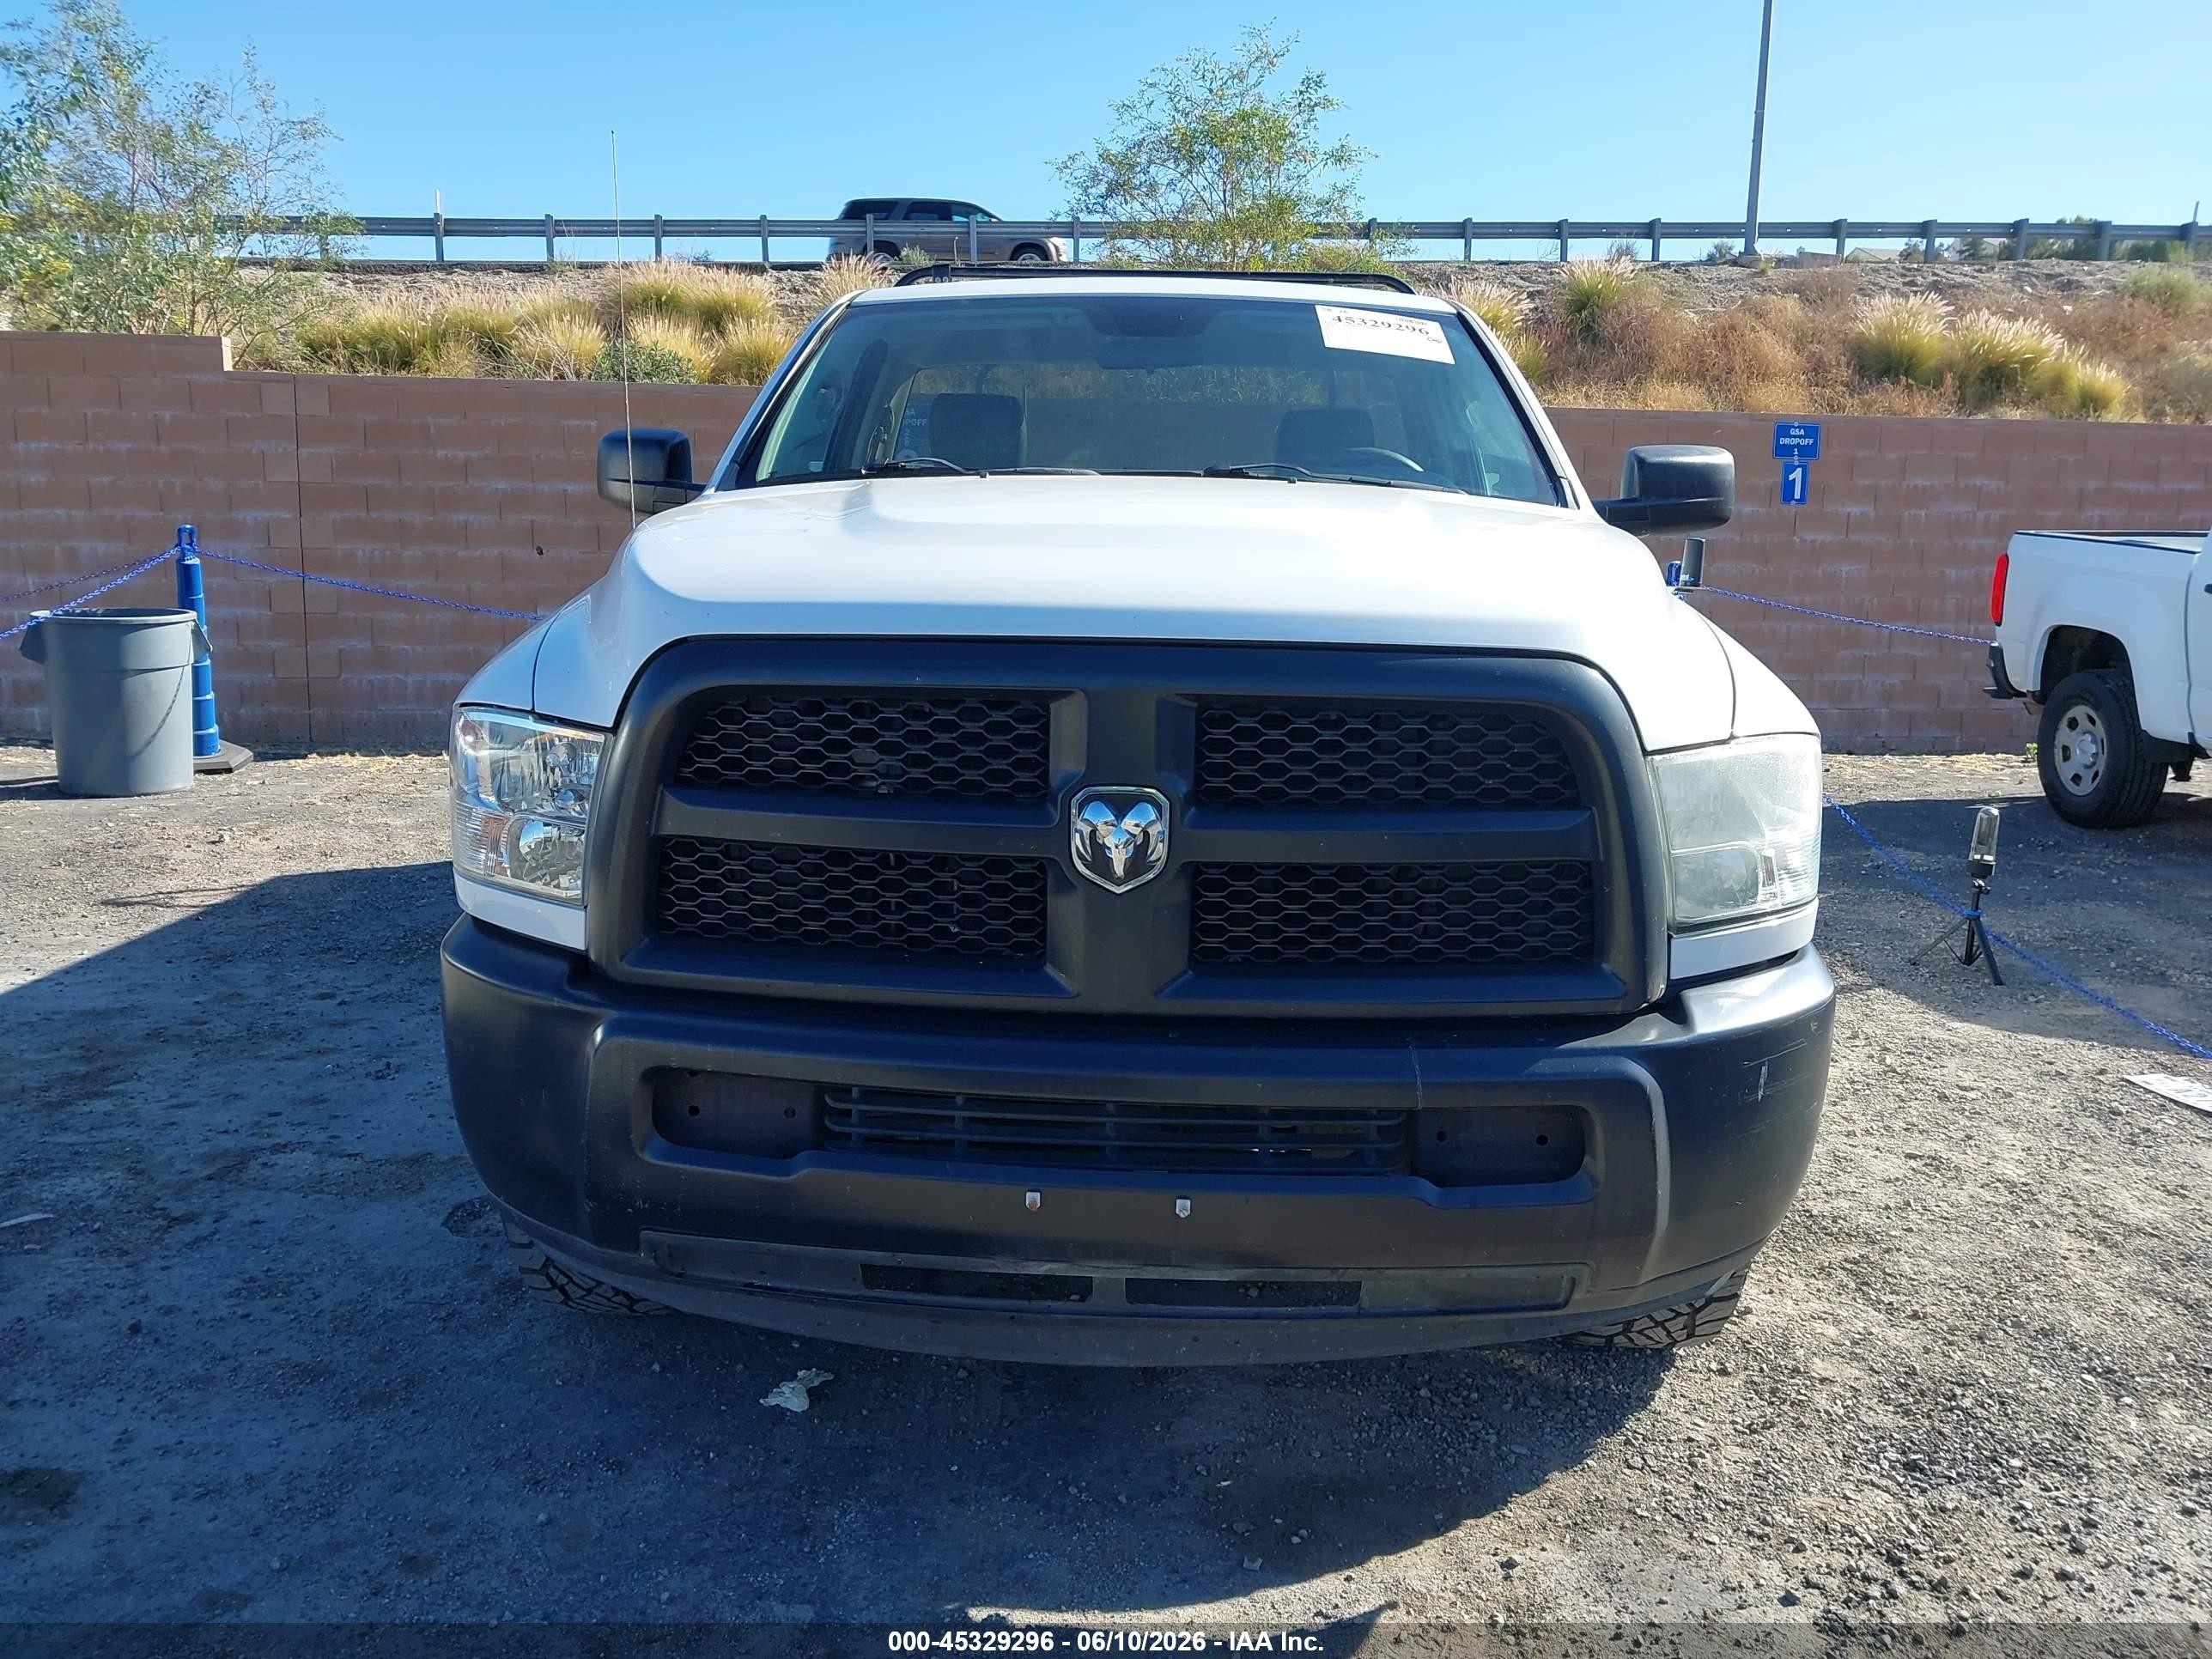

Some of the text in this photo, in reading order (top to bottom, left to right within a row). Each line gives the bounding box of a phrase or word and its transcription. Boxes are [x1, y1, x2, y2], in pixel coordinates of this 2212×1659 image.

[1332, 315, 1430, 335] 45329296
[1779, 437, 1814, 446] DROPOFF
[1789, 467, 1802, 500] 1
